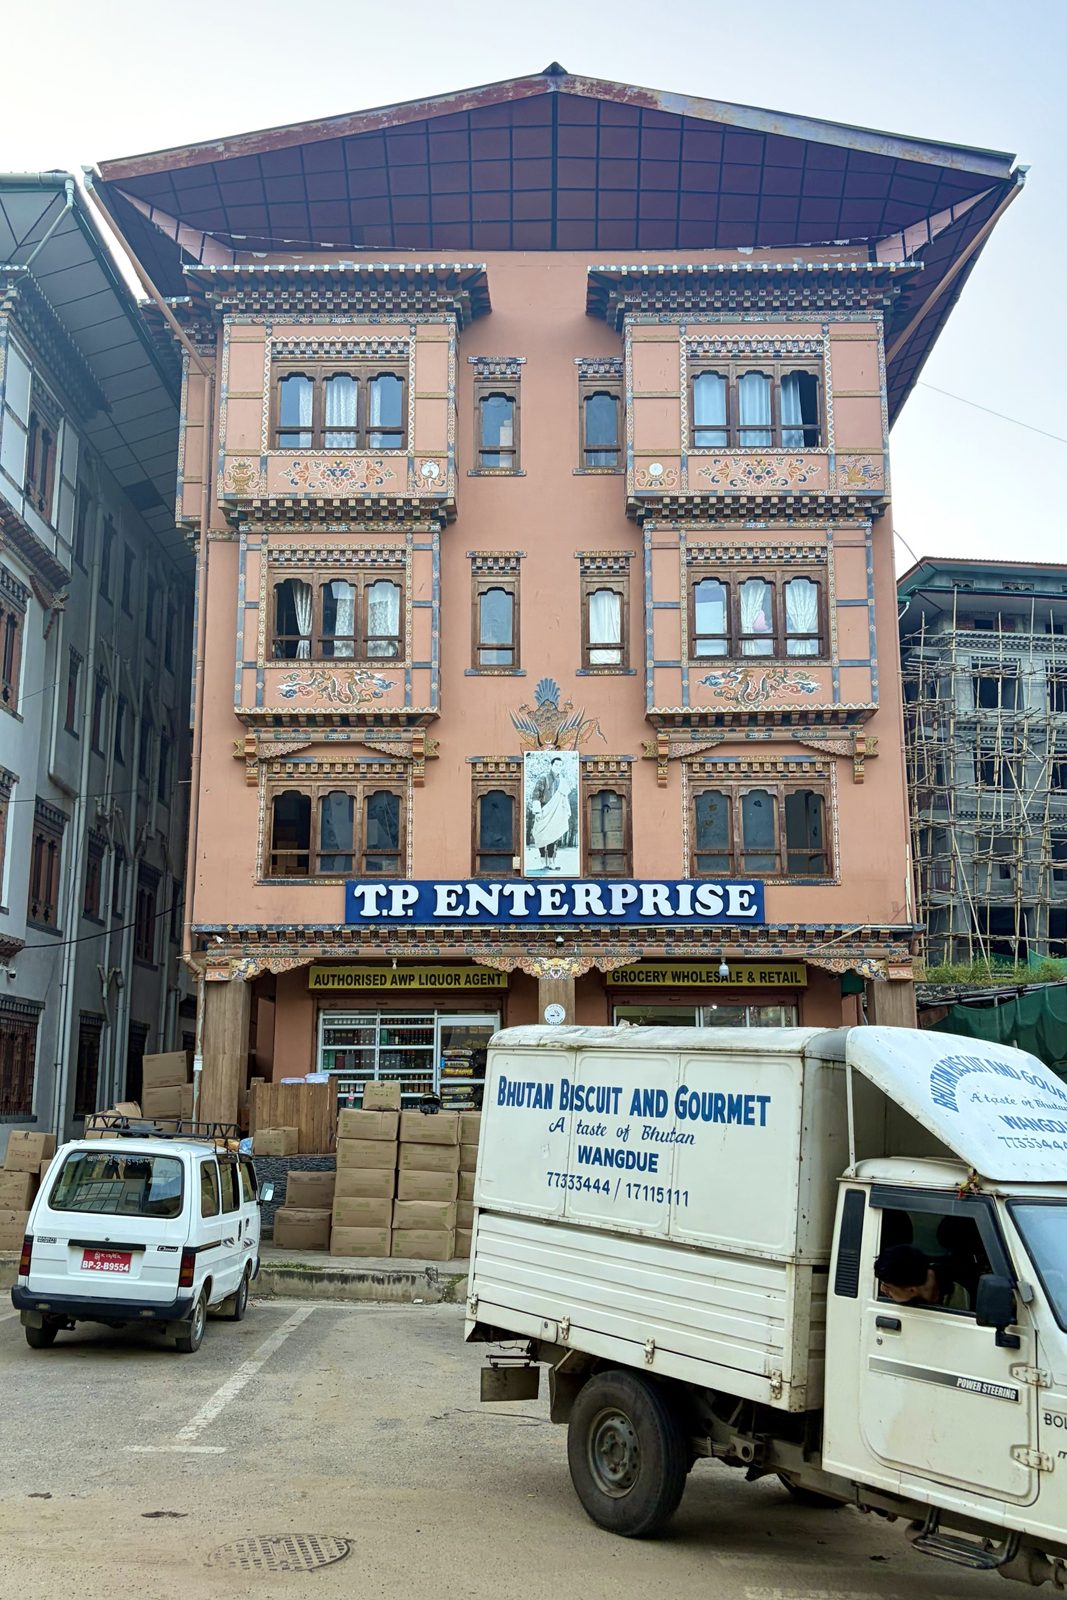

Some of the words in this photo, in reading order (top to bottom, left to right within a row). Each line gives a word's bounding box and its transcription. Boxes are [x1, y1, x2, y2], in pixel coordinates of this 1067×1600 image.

[354, 883, 419, 916] T.P.
[433, 883, 758, 917] ENTERPRISE
[314, 973, 387, 986] AUTHORISED
[390, 973, 415, 986] AWP
[419, 973, 461, 987] LIQUOR
[464, 973, 502, 986] AGENT
[612, 970, 667, 983] GROCERY
[671, 971, 743, 983] WHOLESALE
[747, 971, 756, 984] &
[760, 971, 801, 983] RETAIL
[983, 1058, 1021, 1081] AND
[497, 1075, 554, 1110] BHUTAN
[559, 1078, 623, 1115] BISCUIT
[629, 1088, 668, 1119] AND
[675, 1084, 772, 1127] GOURMET
[970, 1092, 983, 1103] A
[984, 1093, 1017, 1106] taste
[1021, 1099, 1035, 1110] of
[548, 1117, 565, 1133] A
[576, 1119, 607, 1137] taste
[616, 1124, 632, 1142] of
[641, 1124, 697, 1146] Bhutan
[577, 1144, 659, 1173] WANGDUE
[547, 1171, 611, 1196] 77333444
[625, 1182, 690, 1207] 17115111
[82, 1260, 129, 1272] BP-2-B9554
[956, 1377, 982, 1392] POWER
[981, 1383, 1016, 1399] STEERING
